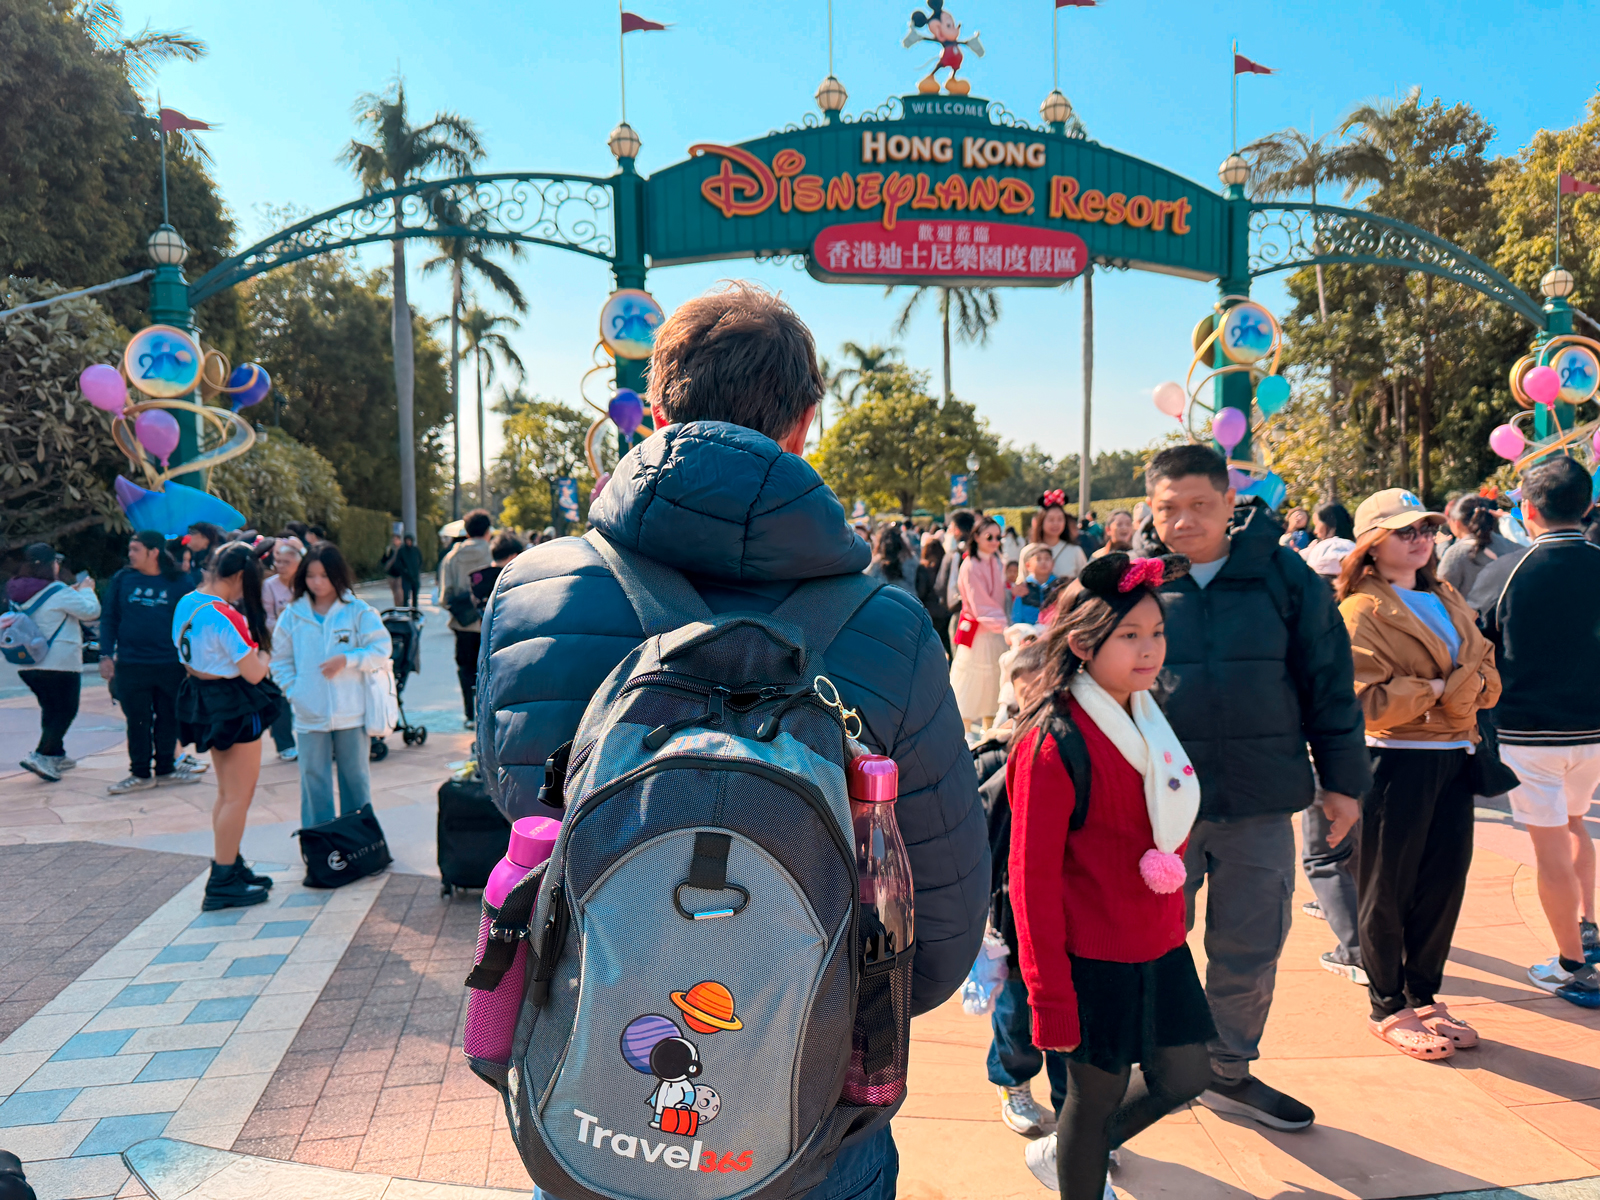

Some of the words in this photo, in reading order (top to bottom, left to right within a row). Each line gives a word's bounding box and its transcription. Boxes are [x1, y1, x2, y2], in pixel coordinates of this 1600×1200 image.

[911, 102, 985, 117] WELCOME
[861, 130, 954, 163] HONG
[962, 136, 1047, 169] KONG
[1049, 174, 1193, 235] Resort
[826, 239, 1078, 273] 香港迪士尼樂園度假區
